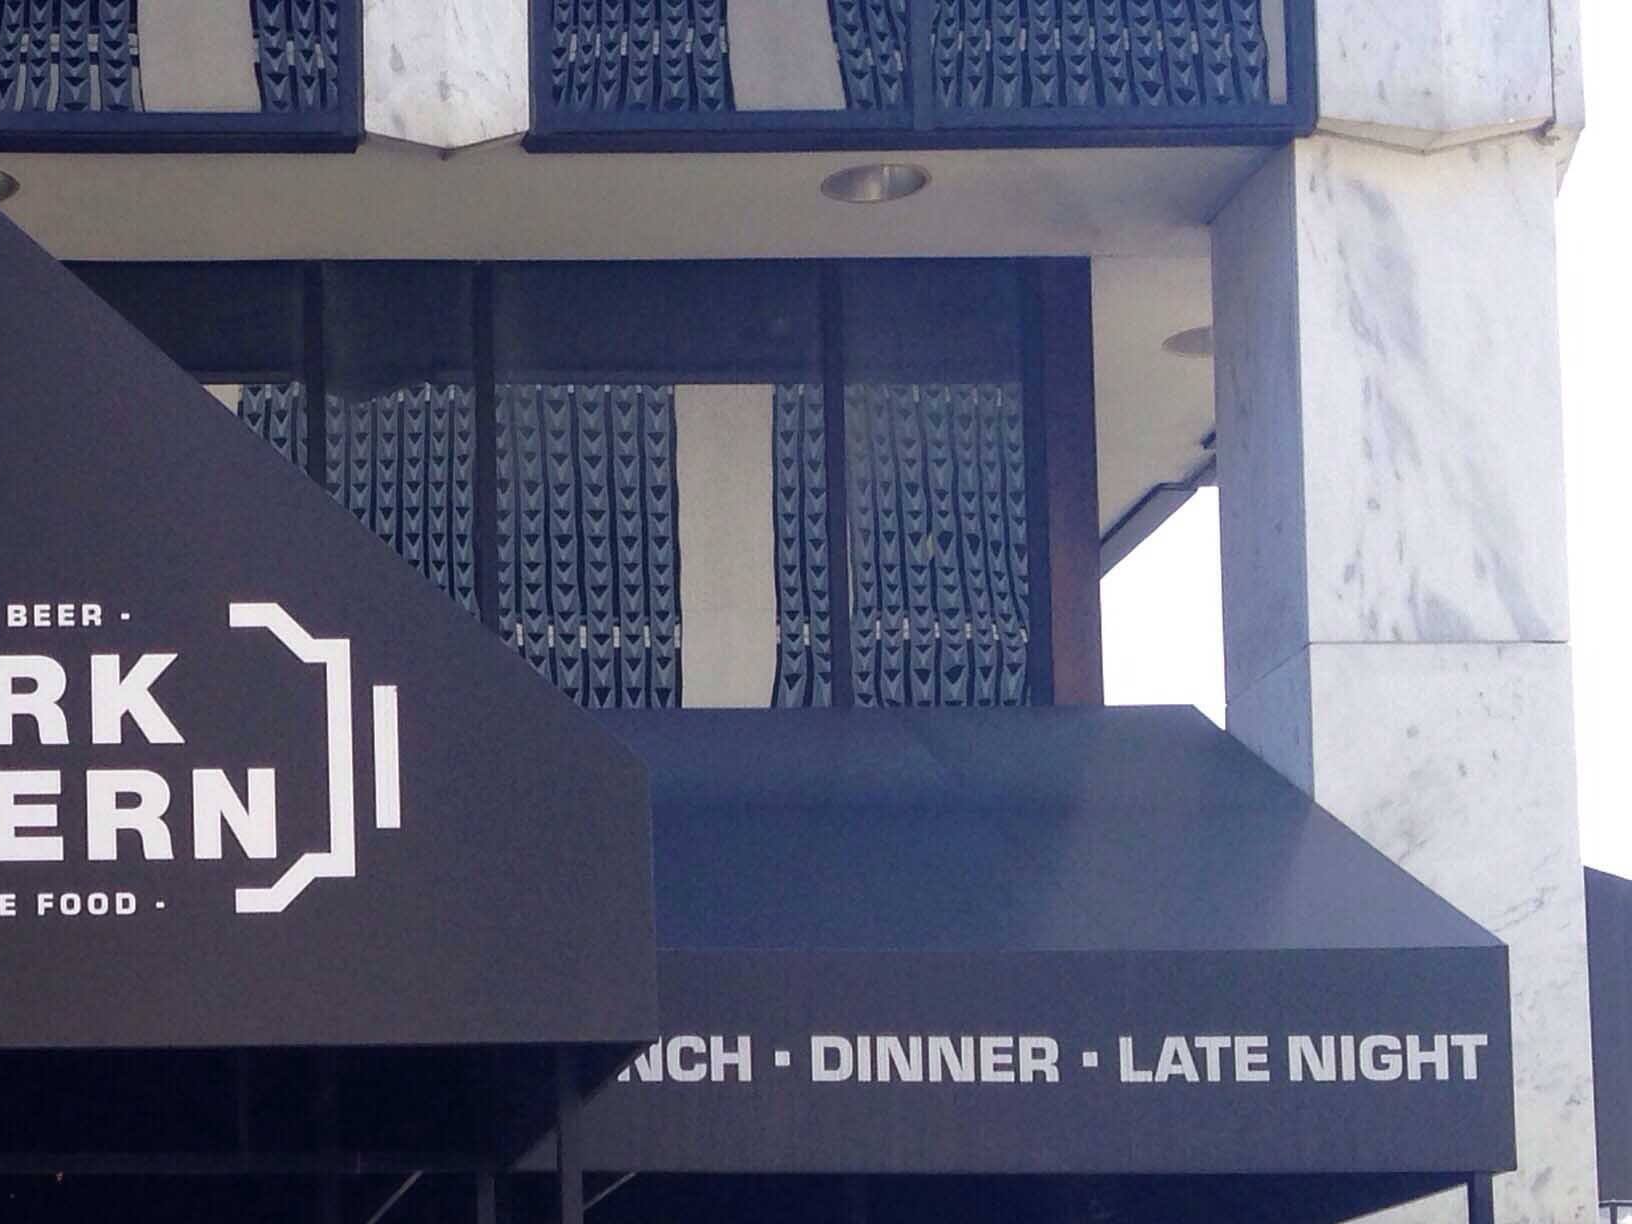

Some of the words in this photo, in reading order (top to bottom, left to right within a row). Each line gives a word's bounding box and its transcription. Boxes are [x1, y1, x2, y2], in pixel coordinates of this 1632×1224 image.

[7, 603, 102, 628] BEER
[37, 891, 137, 916] FOOD
[617, 1035, 752, 1082] NCH
[810, 1035, 1060, 1083] DINNER
[1118, 1035, 1271, 1083] LATE
[1287, 1033, 1489, 1082] NIGHT
